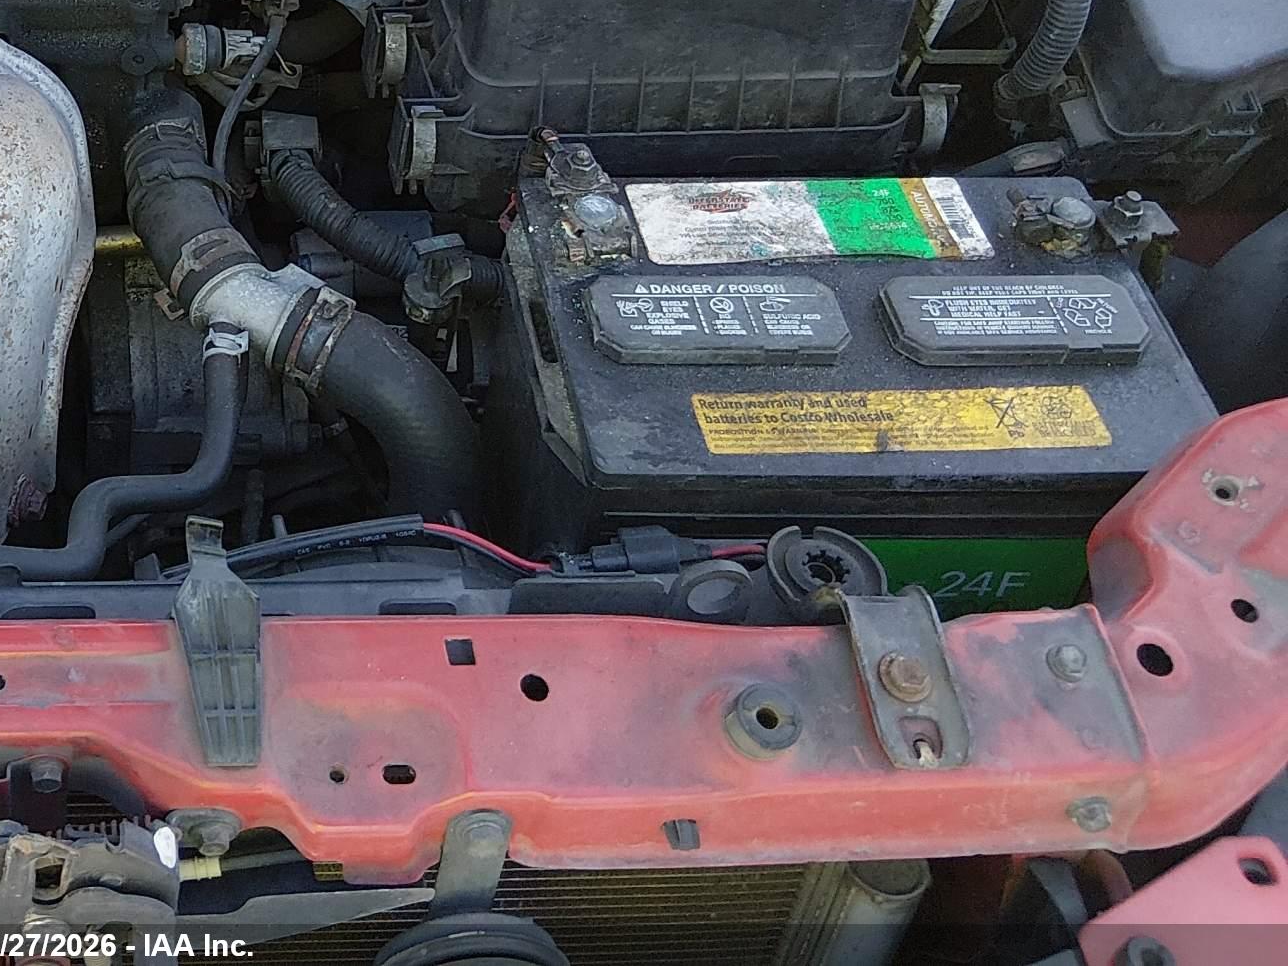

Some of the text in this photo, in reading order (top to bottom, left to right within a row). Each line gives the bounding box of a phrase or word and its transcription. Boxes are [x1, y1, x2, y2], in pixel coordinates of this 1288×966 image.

[650, 284, 787, 294] DANGER / POISON
[698, 396, 868, 411] Return warranty and used
[704, 410, 893, 424] batteries to Costco Wholesale
[933, 570, 1031, 598] 24F
